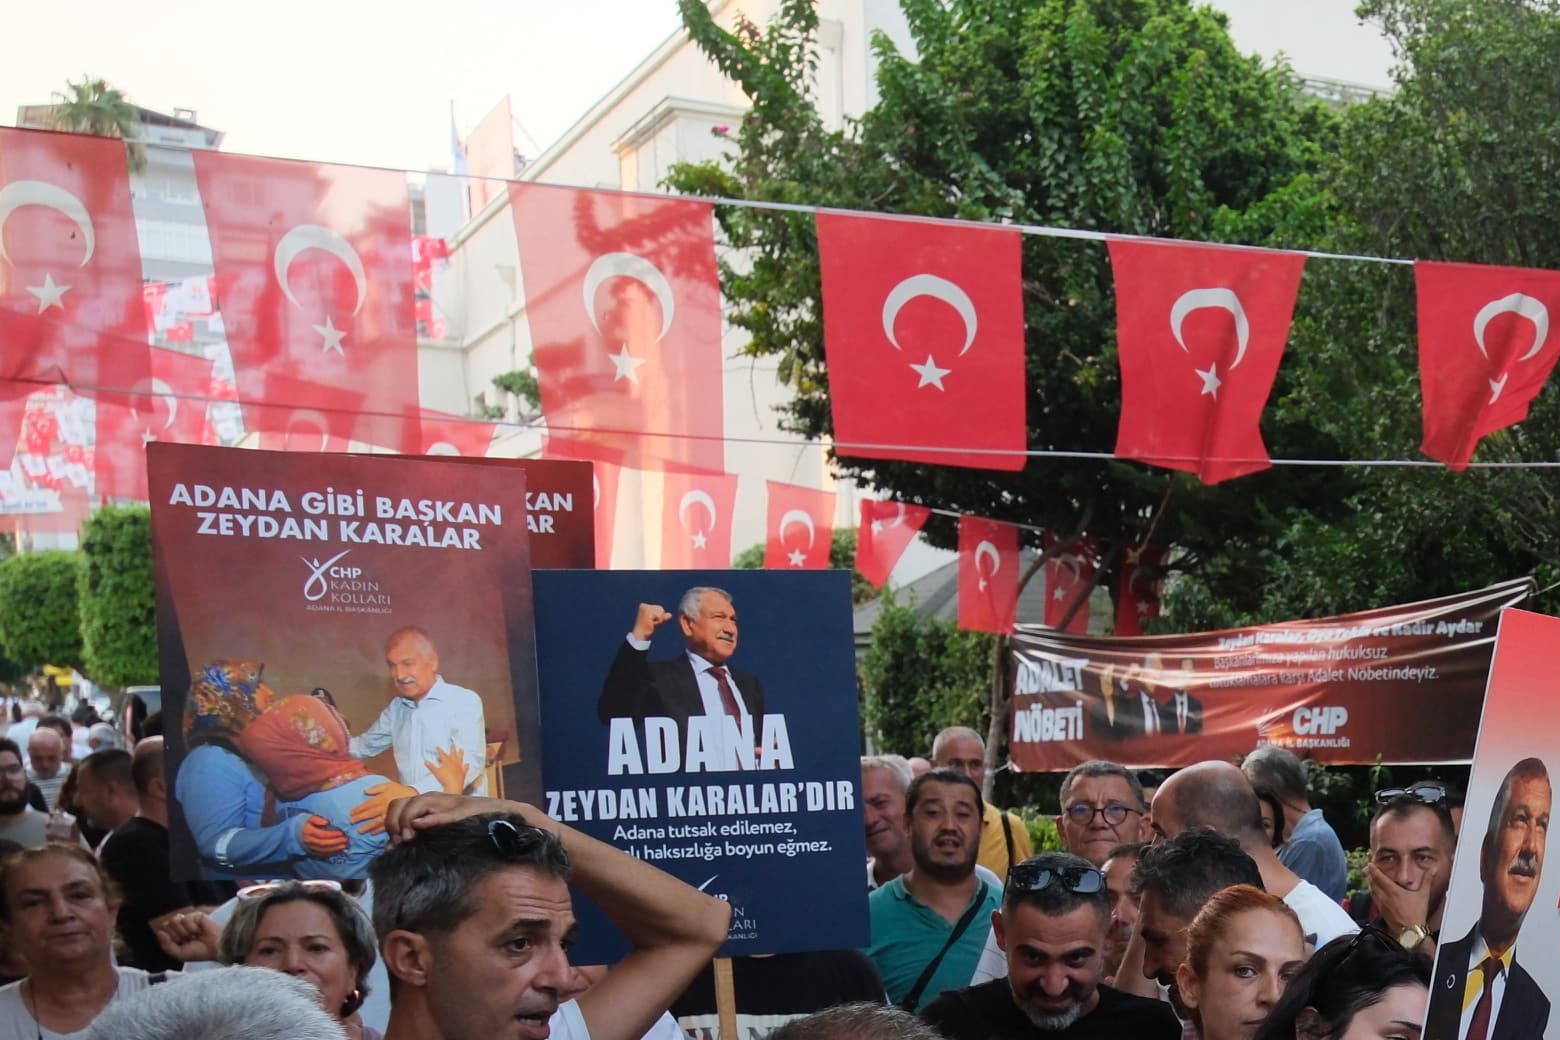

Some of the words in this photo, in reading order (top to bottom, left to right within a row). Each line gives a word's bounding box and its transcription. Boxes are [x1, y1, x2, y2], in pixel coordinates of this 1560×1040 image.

[169, 484, 291, 513] ADANA
[301, 487, 365, 516] GİBİ
[376, 496, 501, 528] BAŞKAN
[197, 512, 328, 541] ZEYDAN
[340, 521, 482, 550] KARALAR
[330, 566, 362, 579] CHP
[331, 580, 379, 592] KADIN
[331, 592, 391, 605] KOLLARI
[1436, 618, 1484, 638] Aydar
[1328, 644, 1388, 660] hukuksuz
[1014, 658, 1089, 695] ADALET
[1307, 667, 1344, 682] Adalet
[1347, 664, 1440, 684] Nöbetindeyiz.
[1013, 699, 1084, 743] NÖBETİ
[1293, 706, 1349, 735] CHP
[608, 713, 795, 776] ADANA
[545, 787, 658, 822] ZEYDAN
[666, 780, 855, 818] KARALAR’DIR
[613, 824, 666, 841] Adana
[668, 822, 717, 839] tutsak
[720, 819, 797, 837] edilemez,
[644, 842, 722, 861] haksızlığa
[725, 840, 774, 858] boyun
[777, 837, 833, 857] eğmez.
